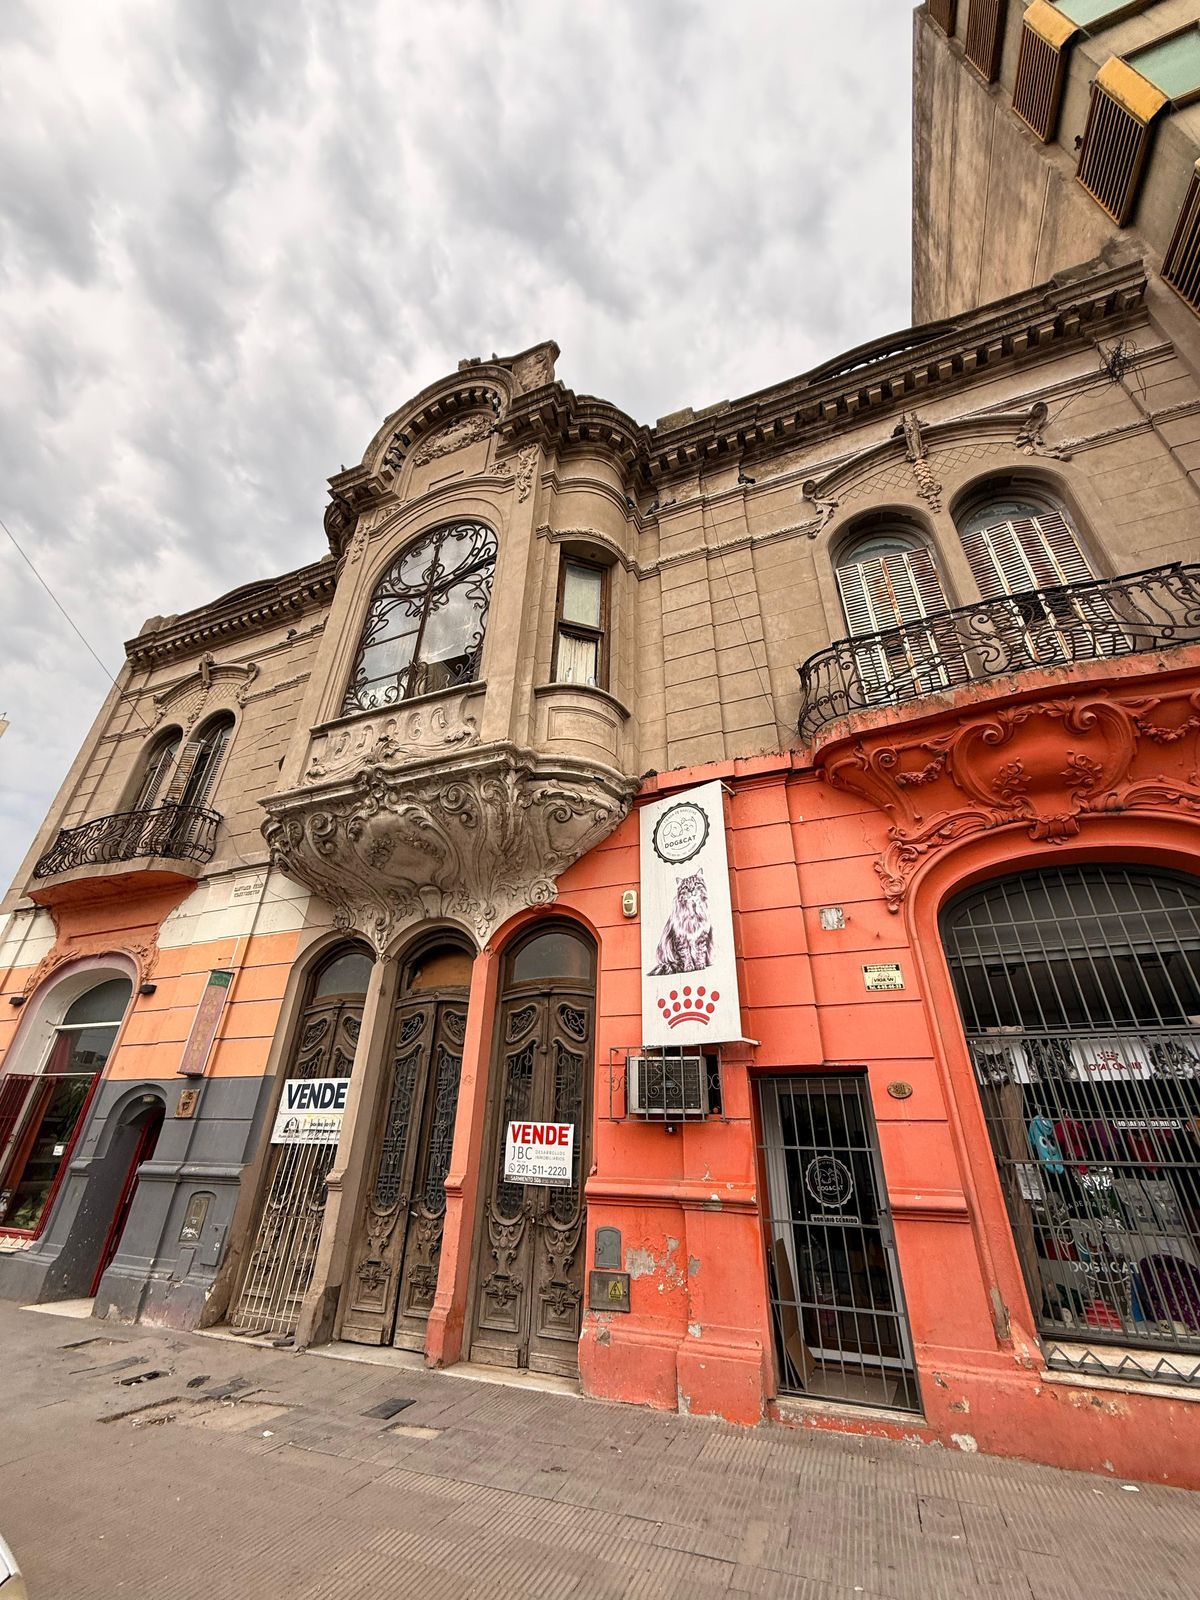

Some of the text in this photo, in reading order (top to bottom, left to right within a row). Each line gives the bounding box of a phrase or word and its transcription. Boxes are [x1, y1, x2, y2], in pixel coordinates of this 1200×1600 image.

[664, 835, 697, 849] DOG&CAT
[288, 1082, 348, 1110] VENDE
[512, 1124, 570, 1145] VENDE
[512, 1146, 533, 1160] JBC
[516, 1163, 567, 1177] 291-511-2220
